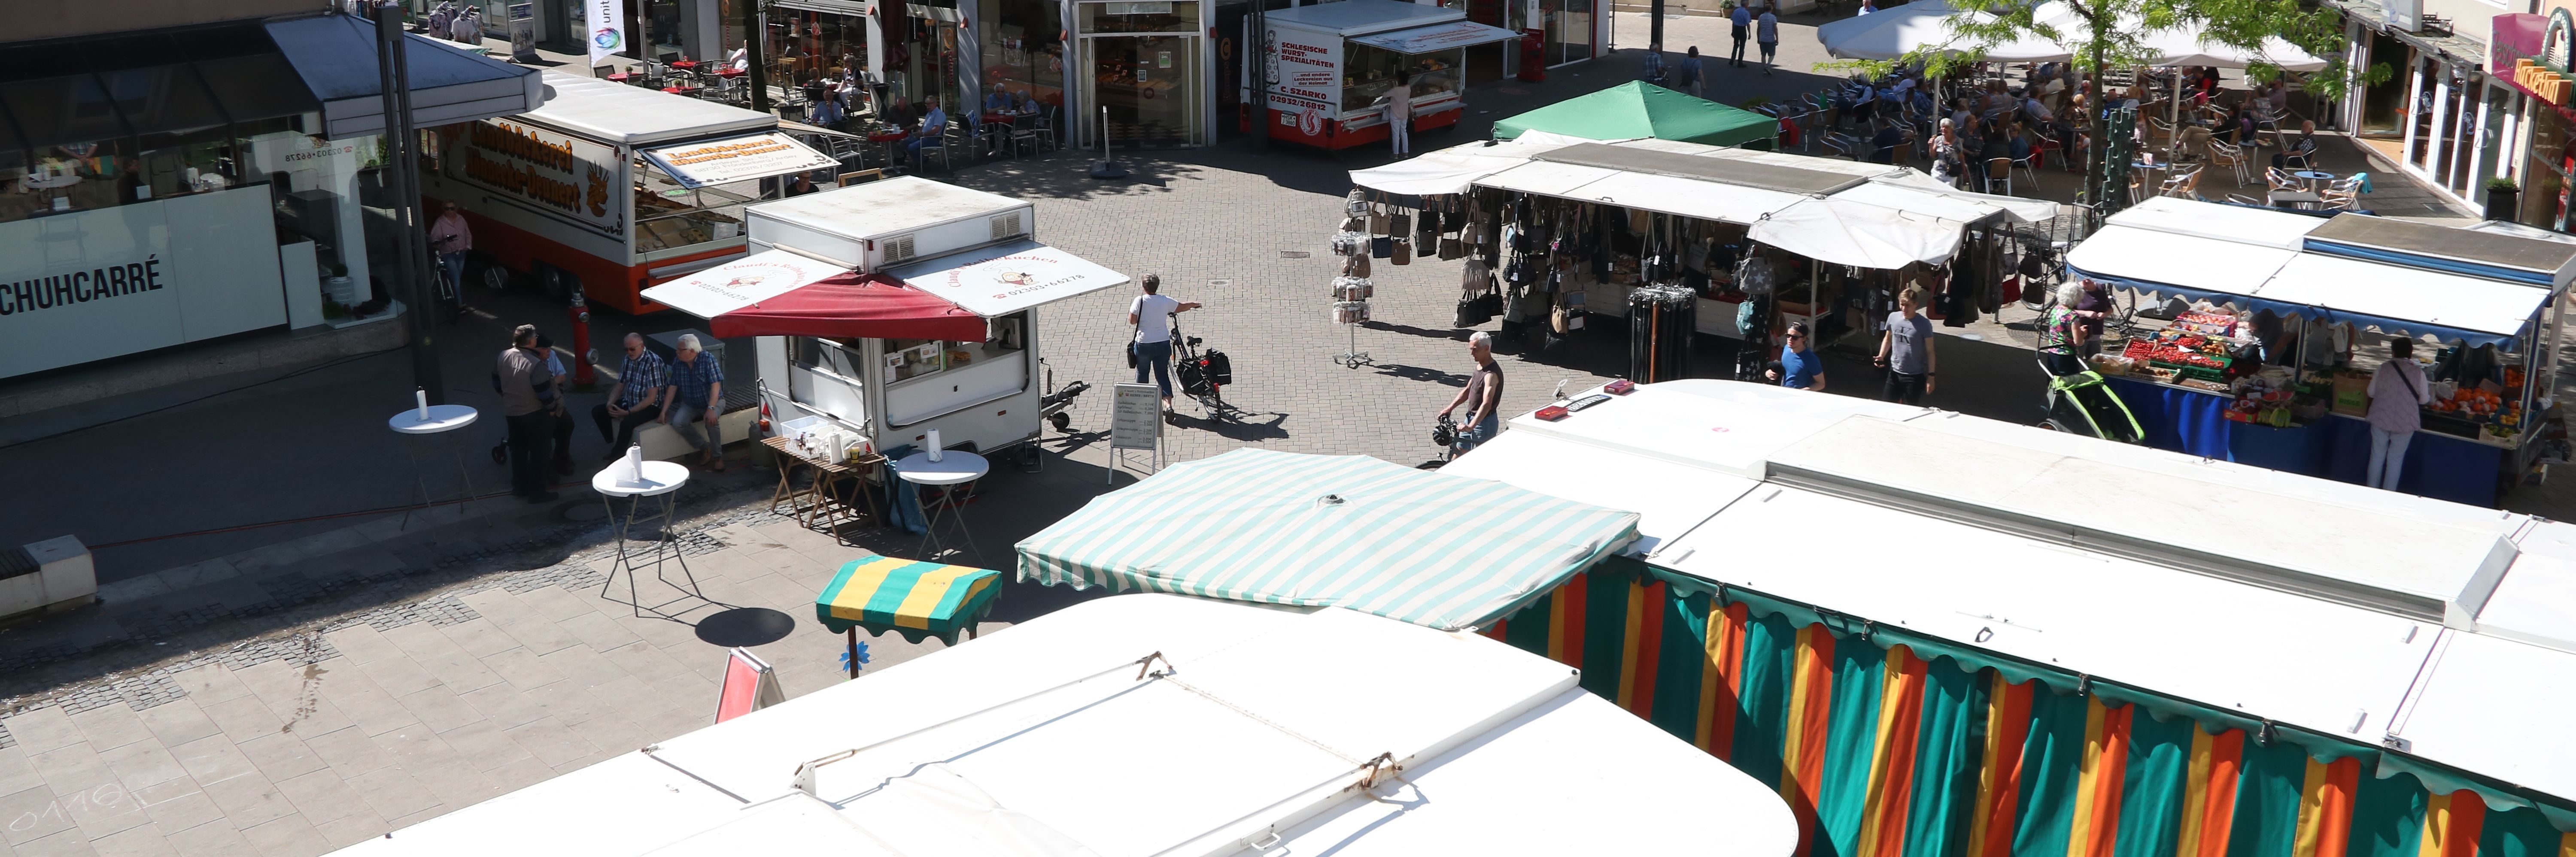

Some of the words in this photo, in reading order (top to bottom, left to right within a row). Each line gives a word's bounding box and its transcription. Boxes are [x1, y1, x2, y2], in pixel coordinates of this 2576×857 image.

[1281, 48, 1307, 57] WURST-
[1282, 42, 1327, 54] SCHLESISCHE
[1281, 55, 1334, 68] SPEZIALITÄTEN
[2513, 59, 2562, 105] Hackethal
[1270, 95, 1326, 111] 02932/26812
[1290, 88, 1327, 100] SZARKO
[471, 121, 574, 174] Landbäckerei
[665, 139, 779, 159] Landbäckerei
[667, 144, 794, 166] Hönnecke-Deunert
[465, 145, 581, 214] Hönnecke-Deunert
[963, 256, 1058, 267] Reibekuchen
[0, 254, 163, 315] CHUHCARRÉ
